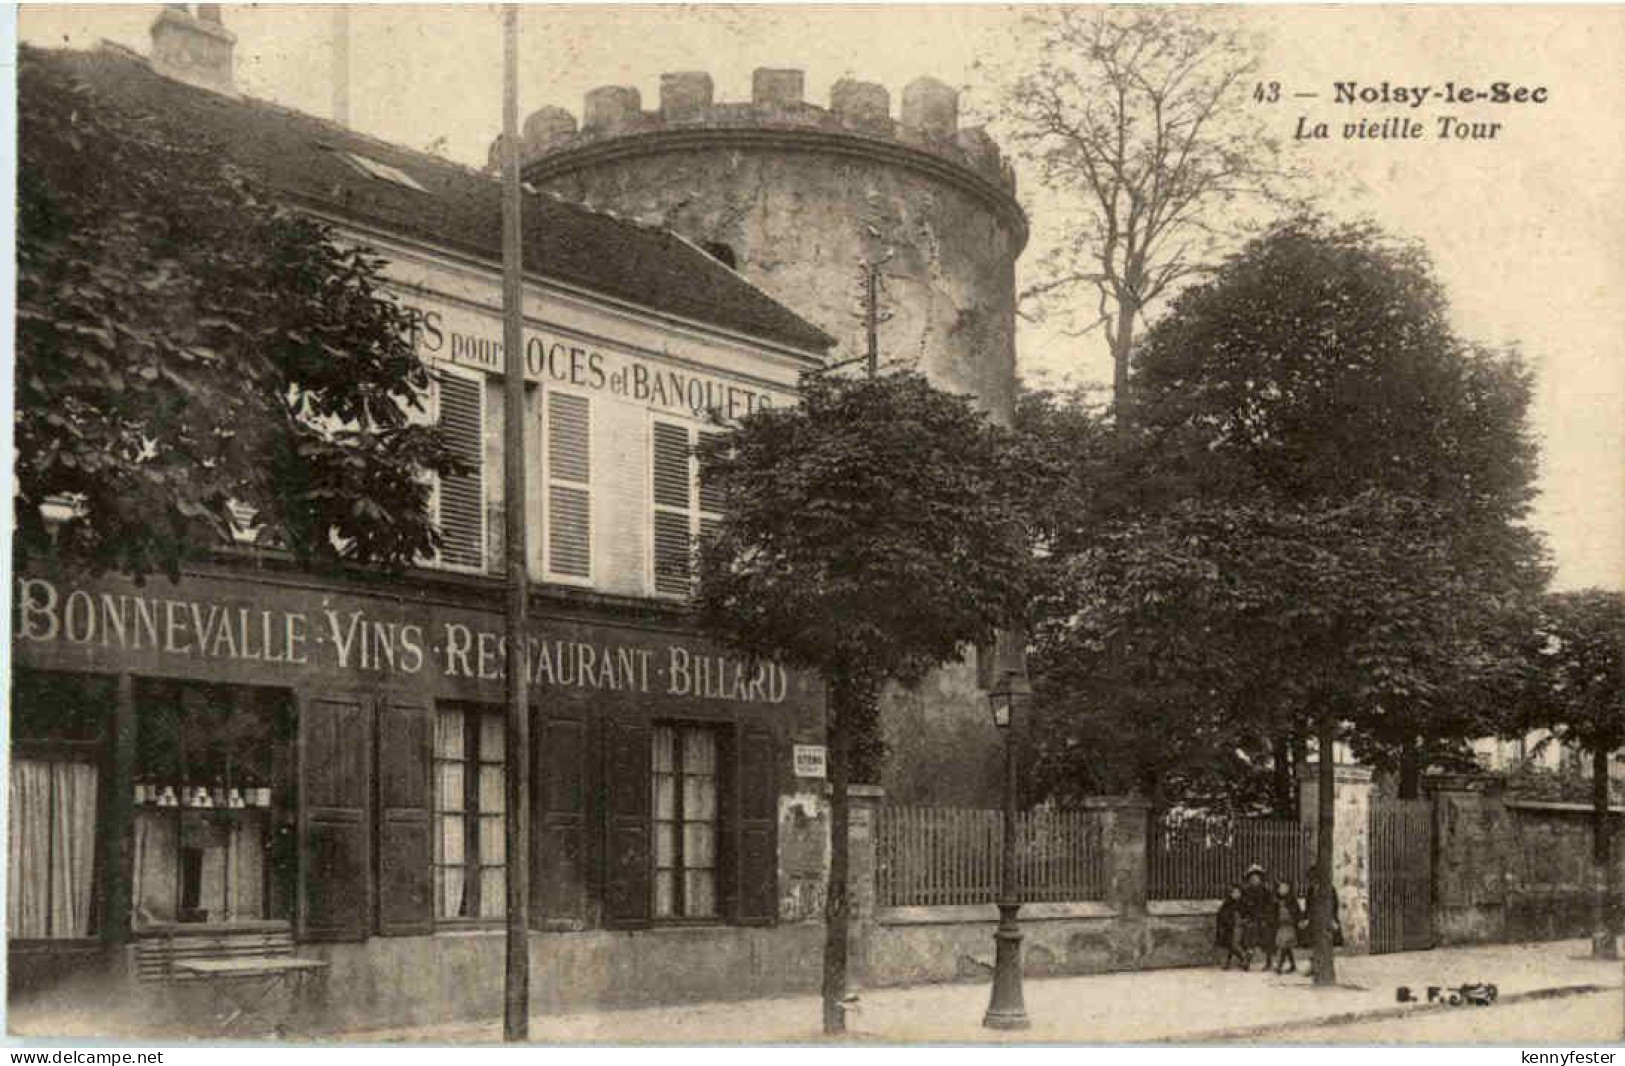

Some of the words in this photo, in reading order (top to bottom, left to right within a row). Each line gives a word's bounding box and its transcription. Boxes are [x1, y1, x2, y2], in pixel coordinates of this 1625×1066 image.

[451, 333, 503, 366] pour
[526, 336, 606, 391] OCES
[609, 366, 629, 396] et
[17, 576, 308, 665] BONNEVALLE
[322, 600, 424, 674] VINS
[667, 644, 789, 704] BILLARD
